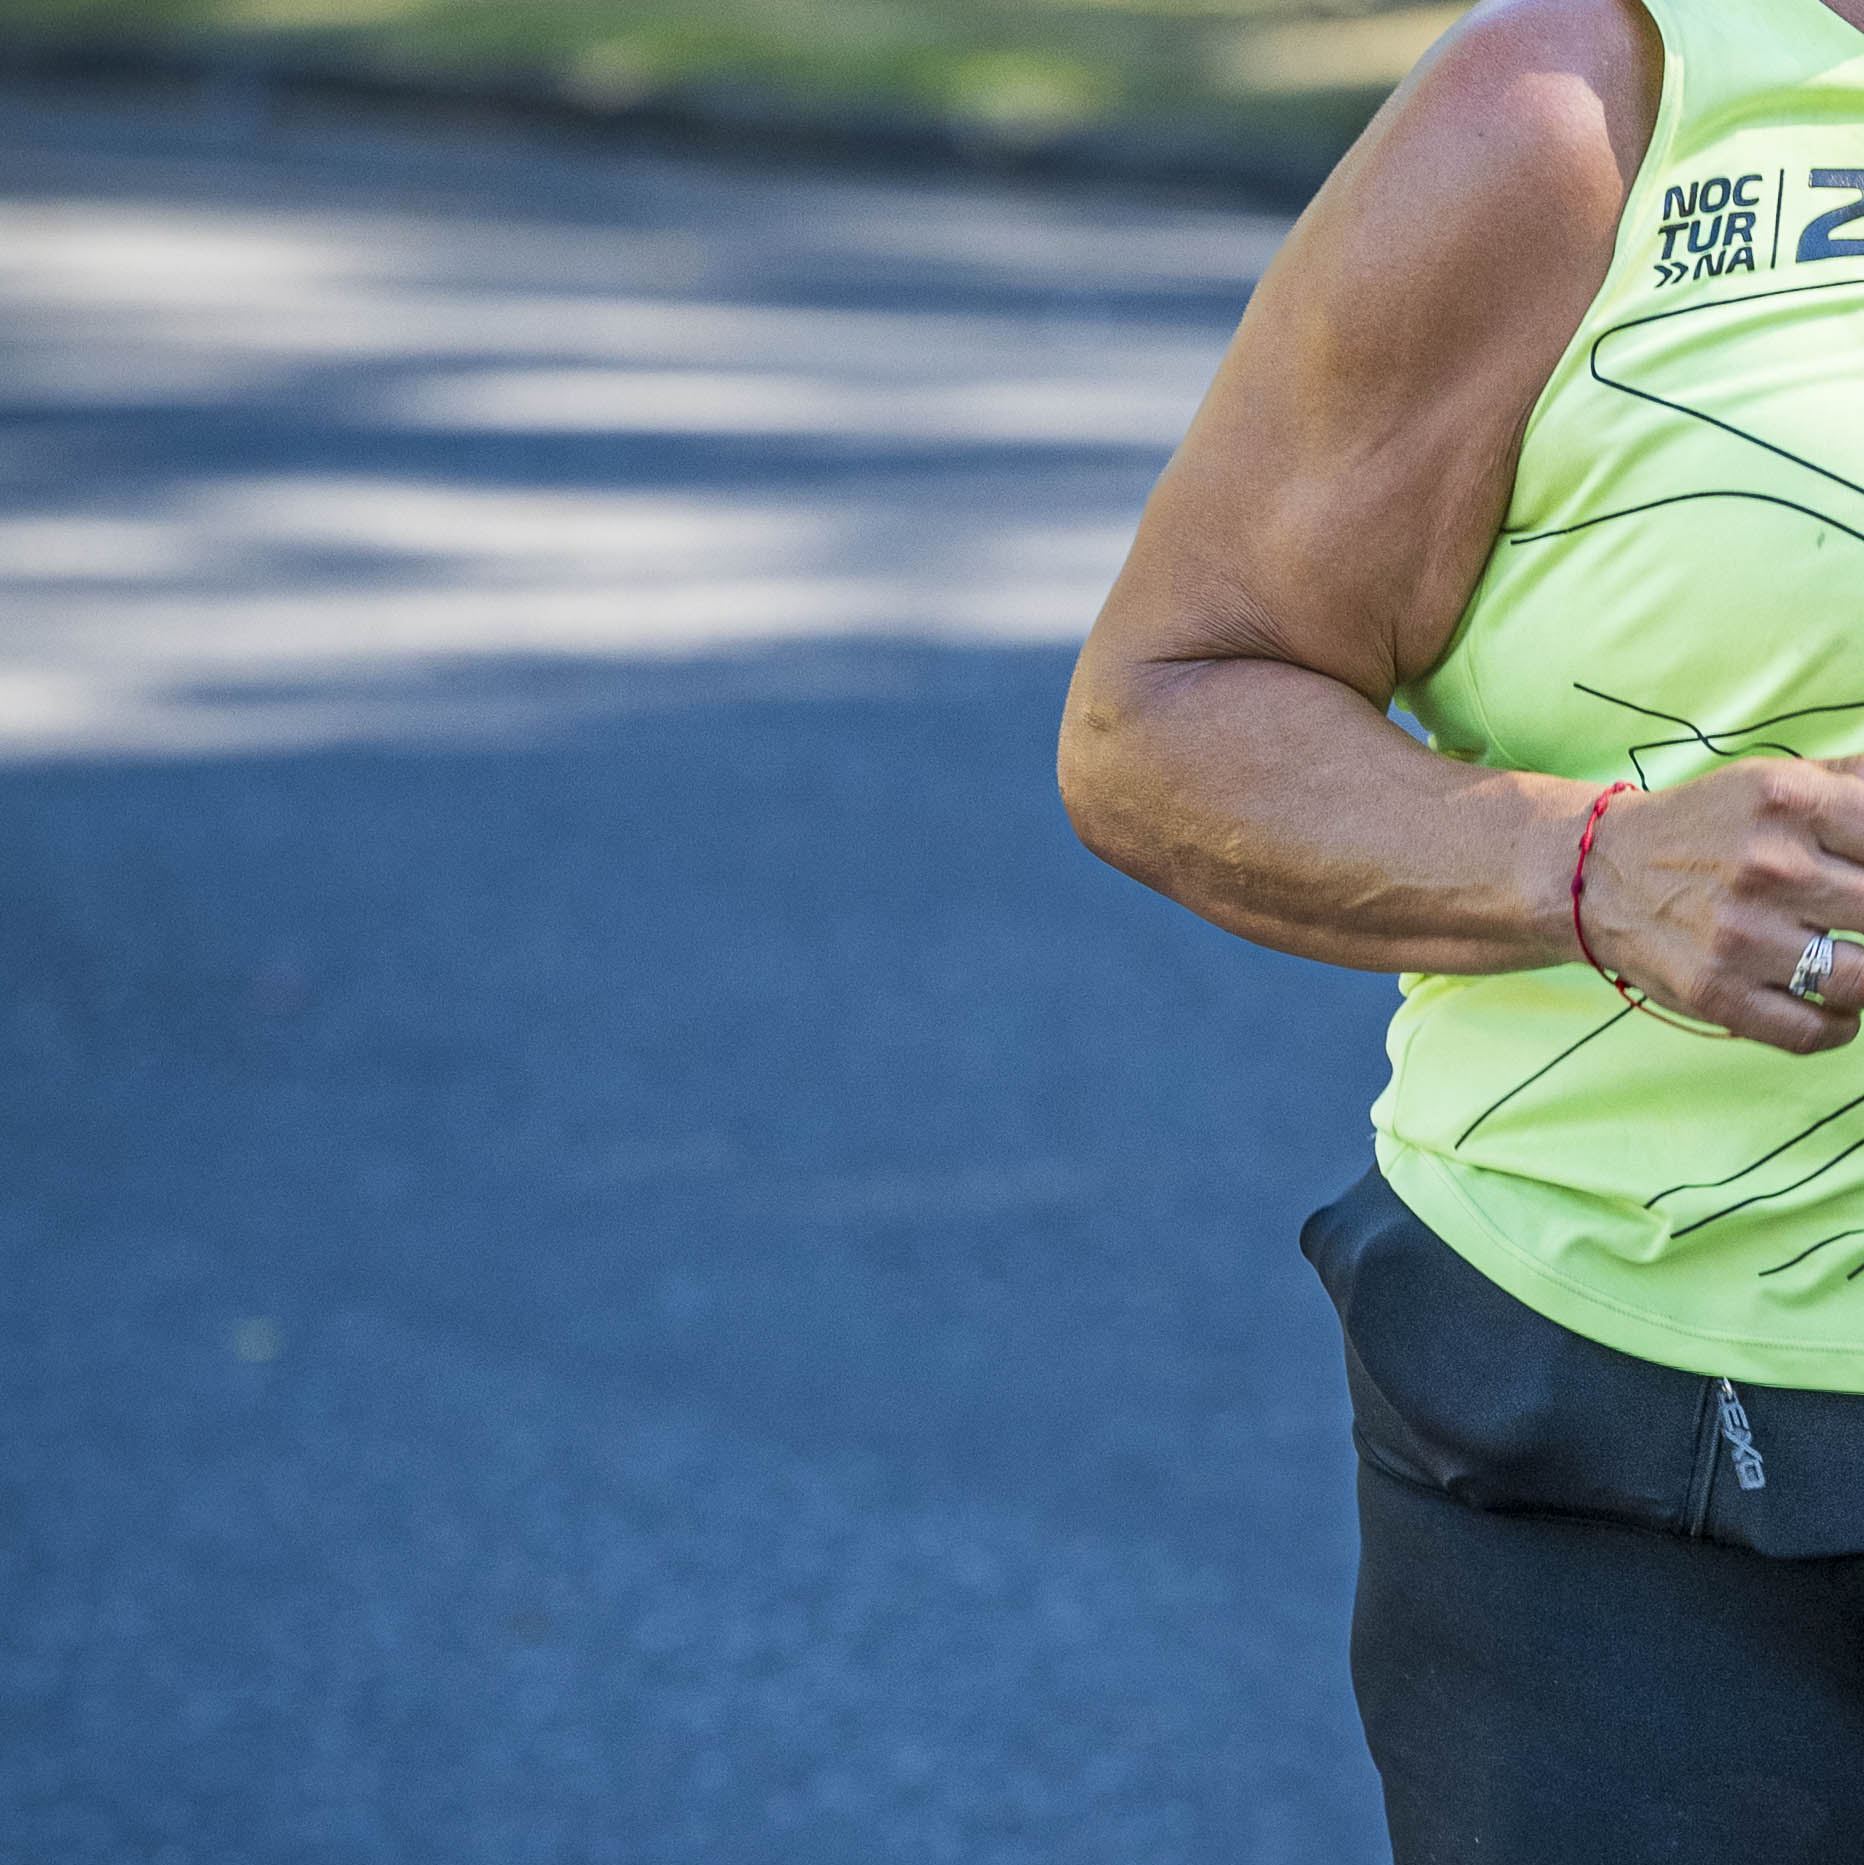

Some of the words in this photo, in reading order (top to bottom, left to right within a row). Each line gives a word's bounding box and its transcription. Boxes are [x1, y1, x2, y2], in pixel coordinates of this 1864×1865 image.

[1663, 174, 1763, 221] NOC
[1658, 211, 1756, 261] TUR
[1722, 1404, 1766, 1490] EXO
